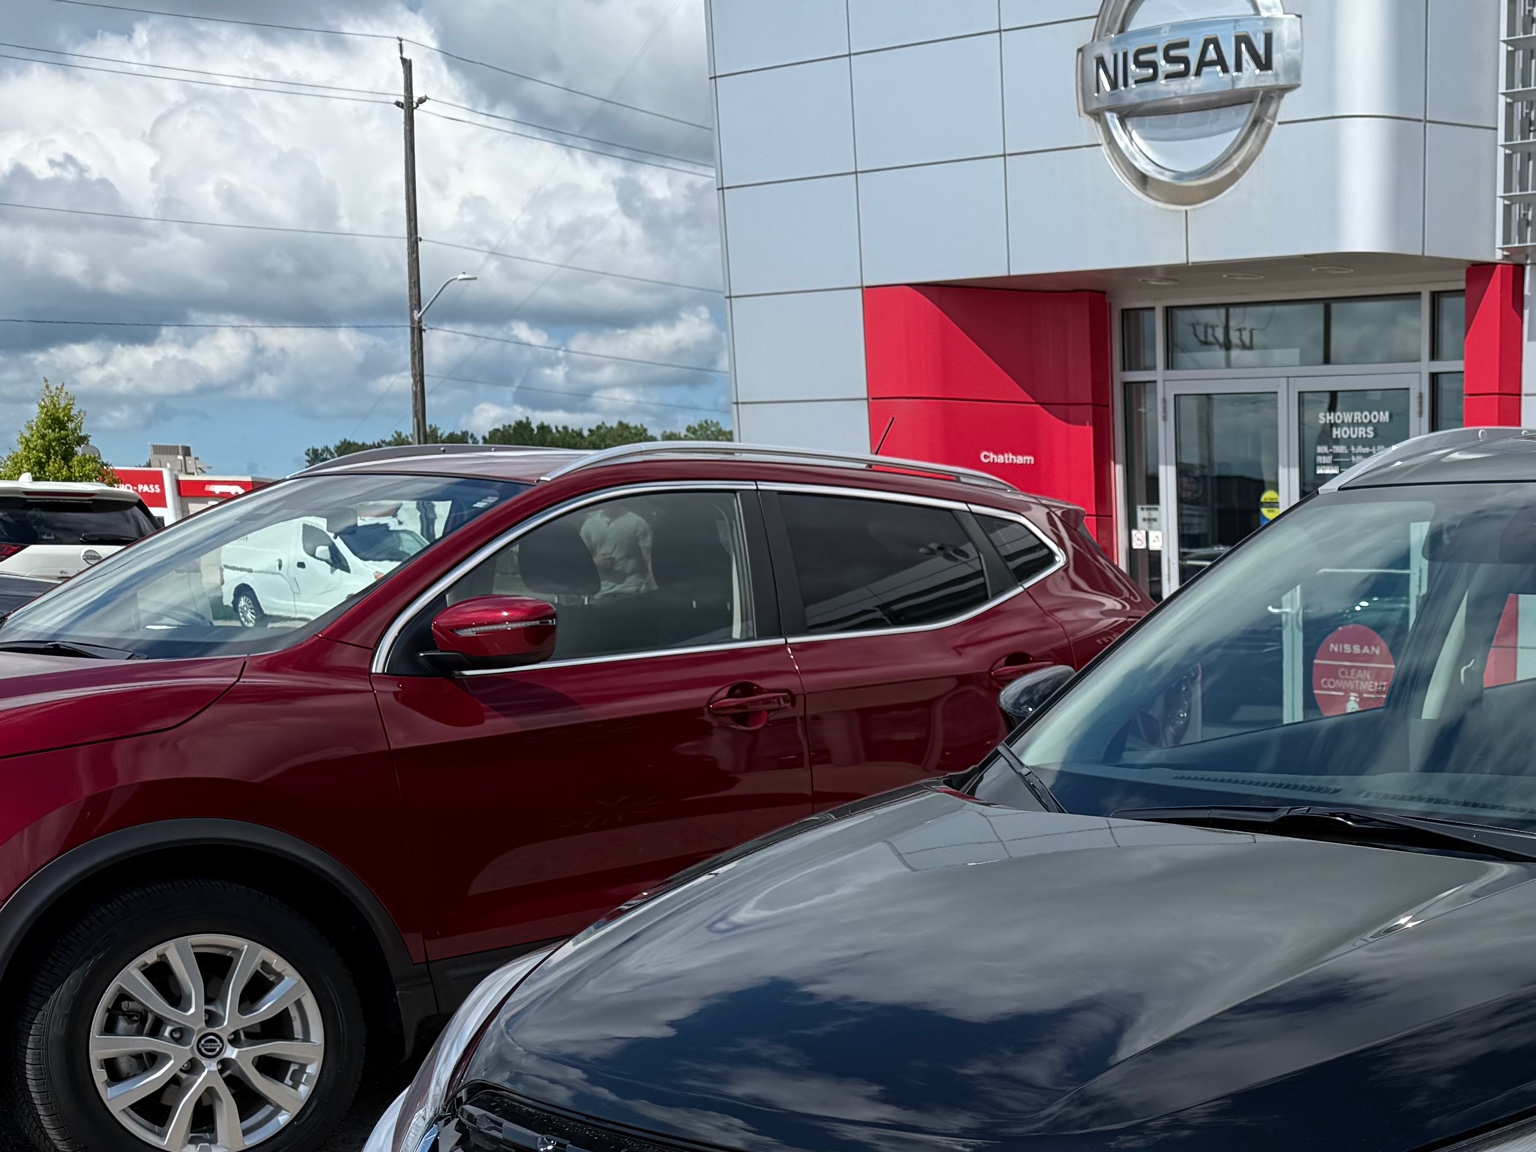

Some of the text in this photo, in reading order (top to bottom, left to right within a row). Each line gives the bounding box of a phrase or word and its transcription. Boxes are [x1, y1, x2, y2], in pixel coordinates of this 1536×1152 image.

[1094, 29, 1273, 96] NISSAN
[1318, 411, 1390, 424] SHOWROOM
[1332, 426, 1375, 439] HOURS
[980, 451, 1035, 465] Chatham
[1329, 643, 1381, 655] NISSAN
[1338, 668, 1371, 679] CLEAN
[1320, 678, 1388, 692] COMMITMENT
